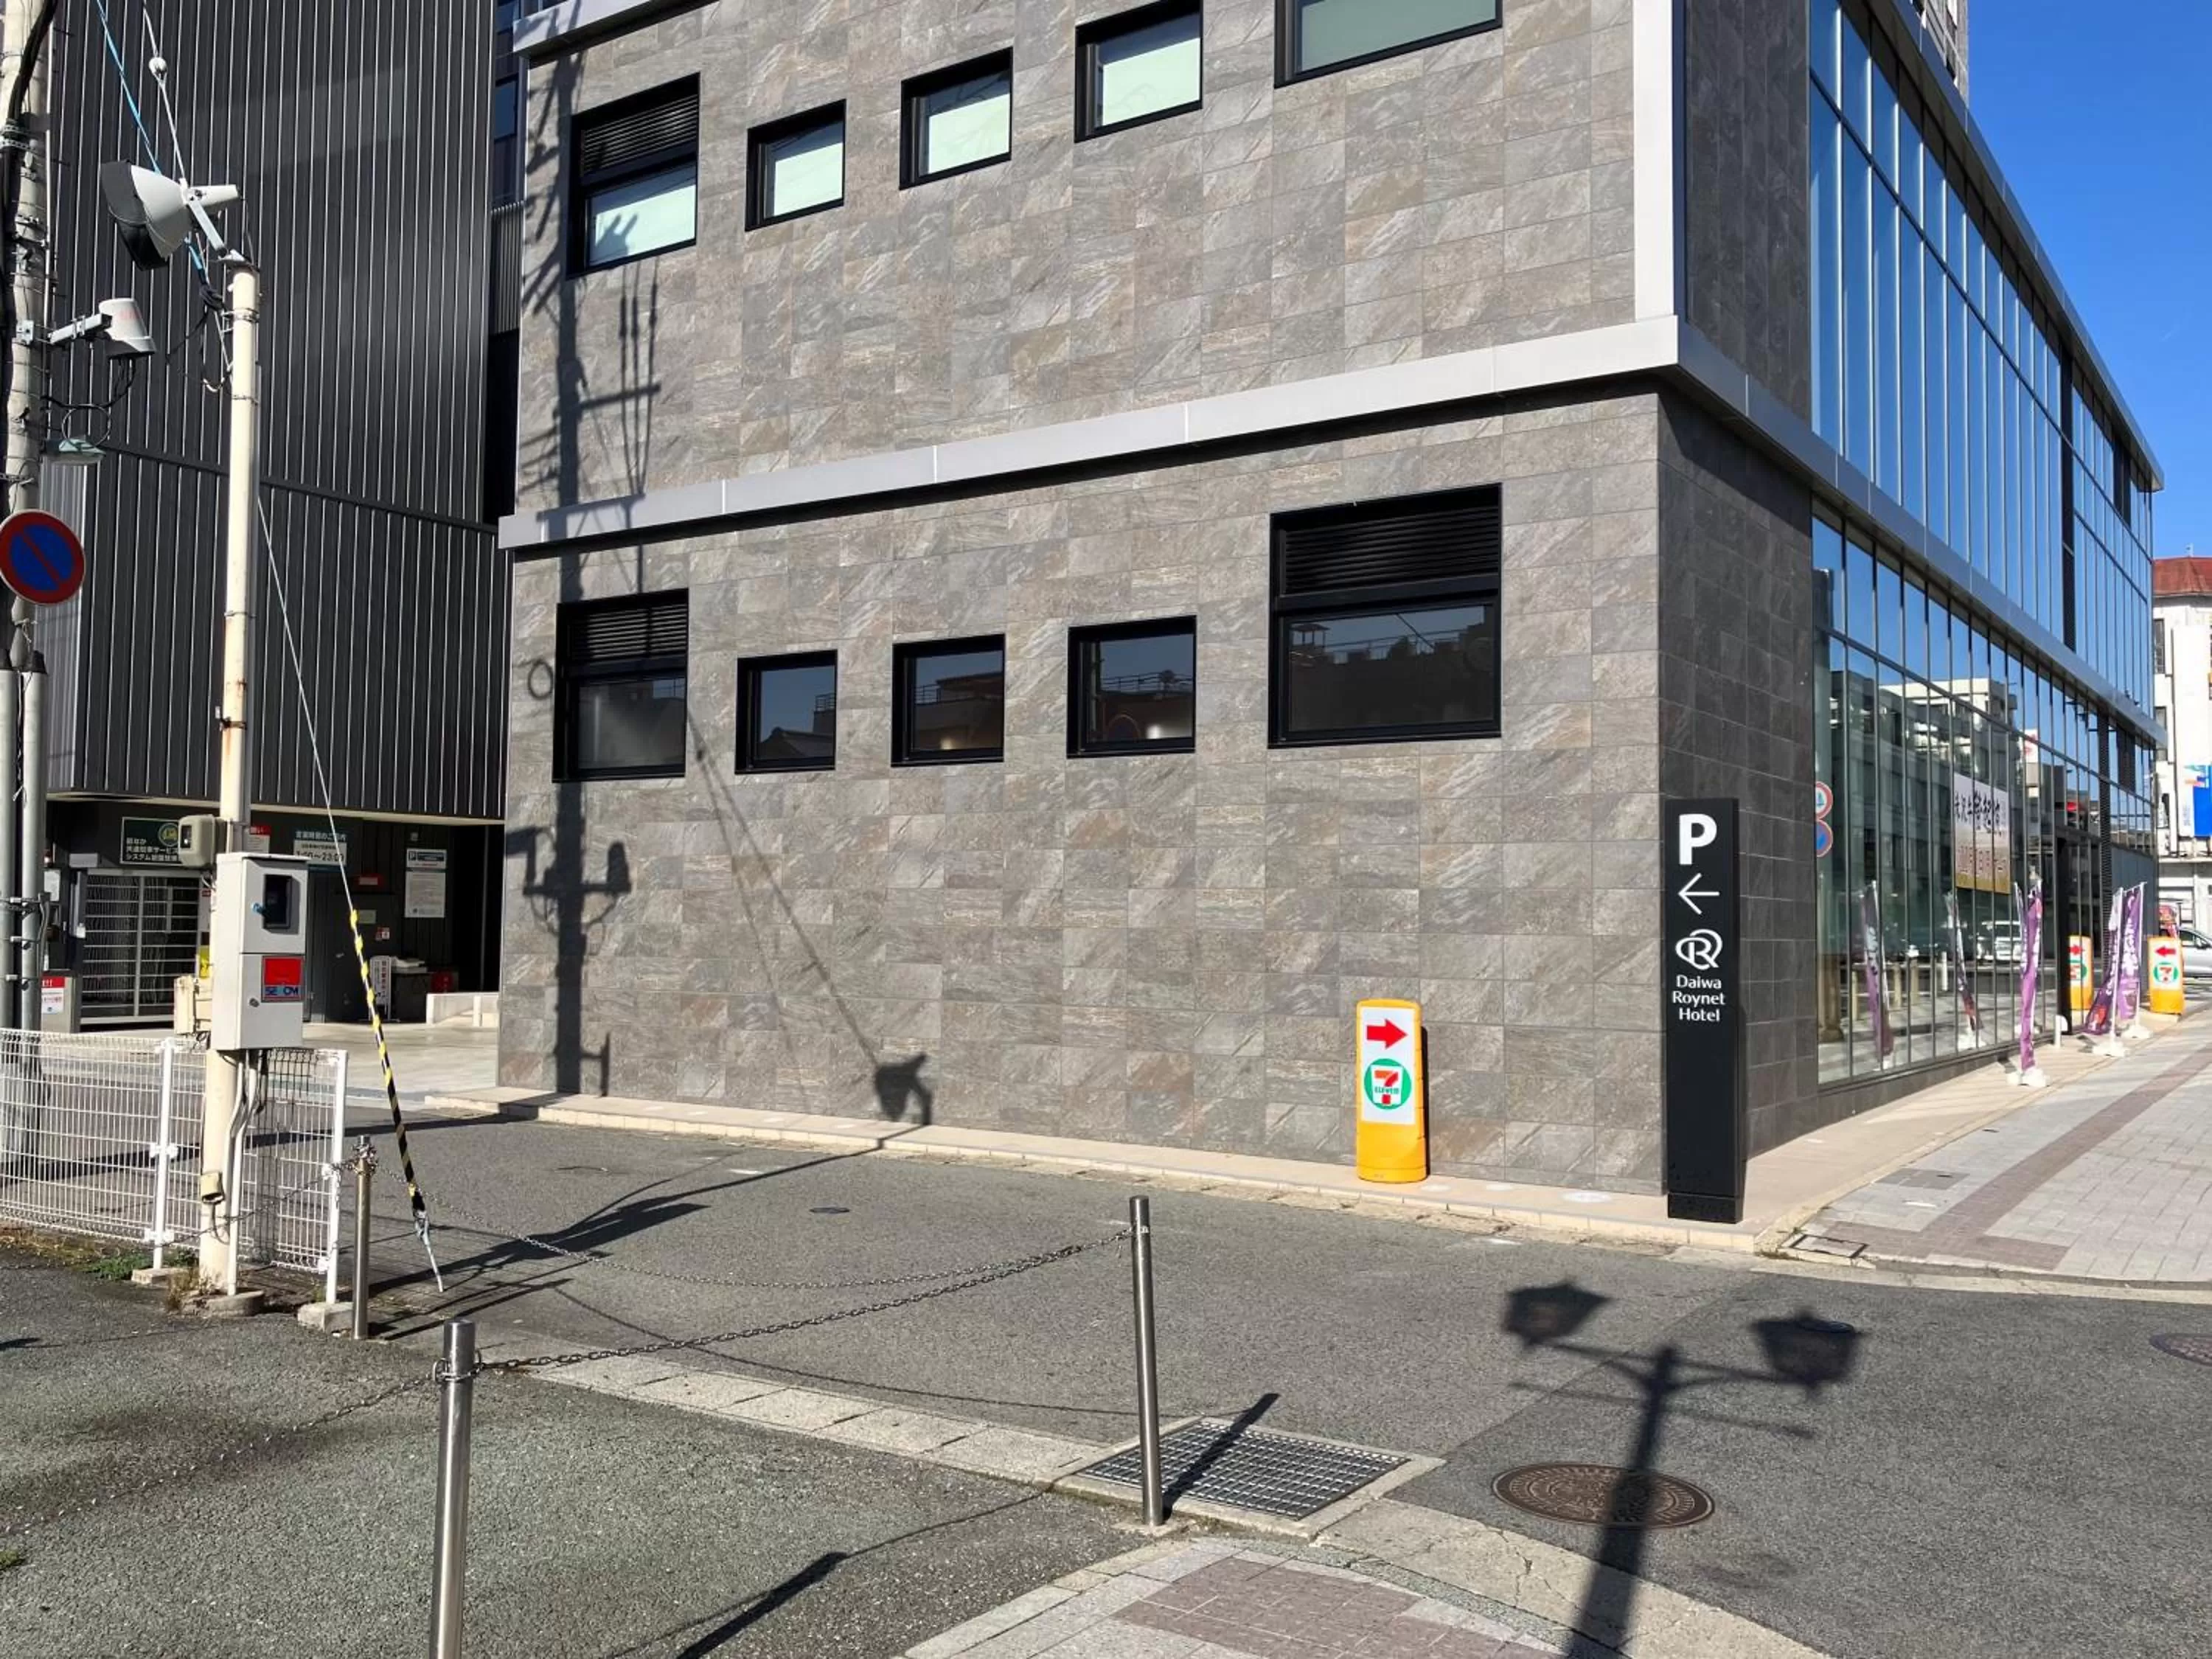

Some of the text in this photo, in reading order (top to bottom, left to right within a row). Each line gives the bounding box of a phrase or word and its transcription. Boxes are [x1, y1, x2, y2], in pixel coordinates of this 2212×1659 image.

[1678, 813, 1717, 865] P
[1676, 974, 1722, 990] Daiwa
[1672, 990, 1725, 1008] Roynet
[1678, 1007, 1721, 1021] Hotel
